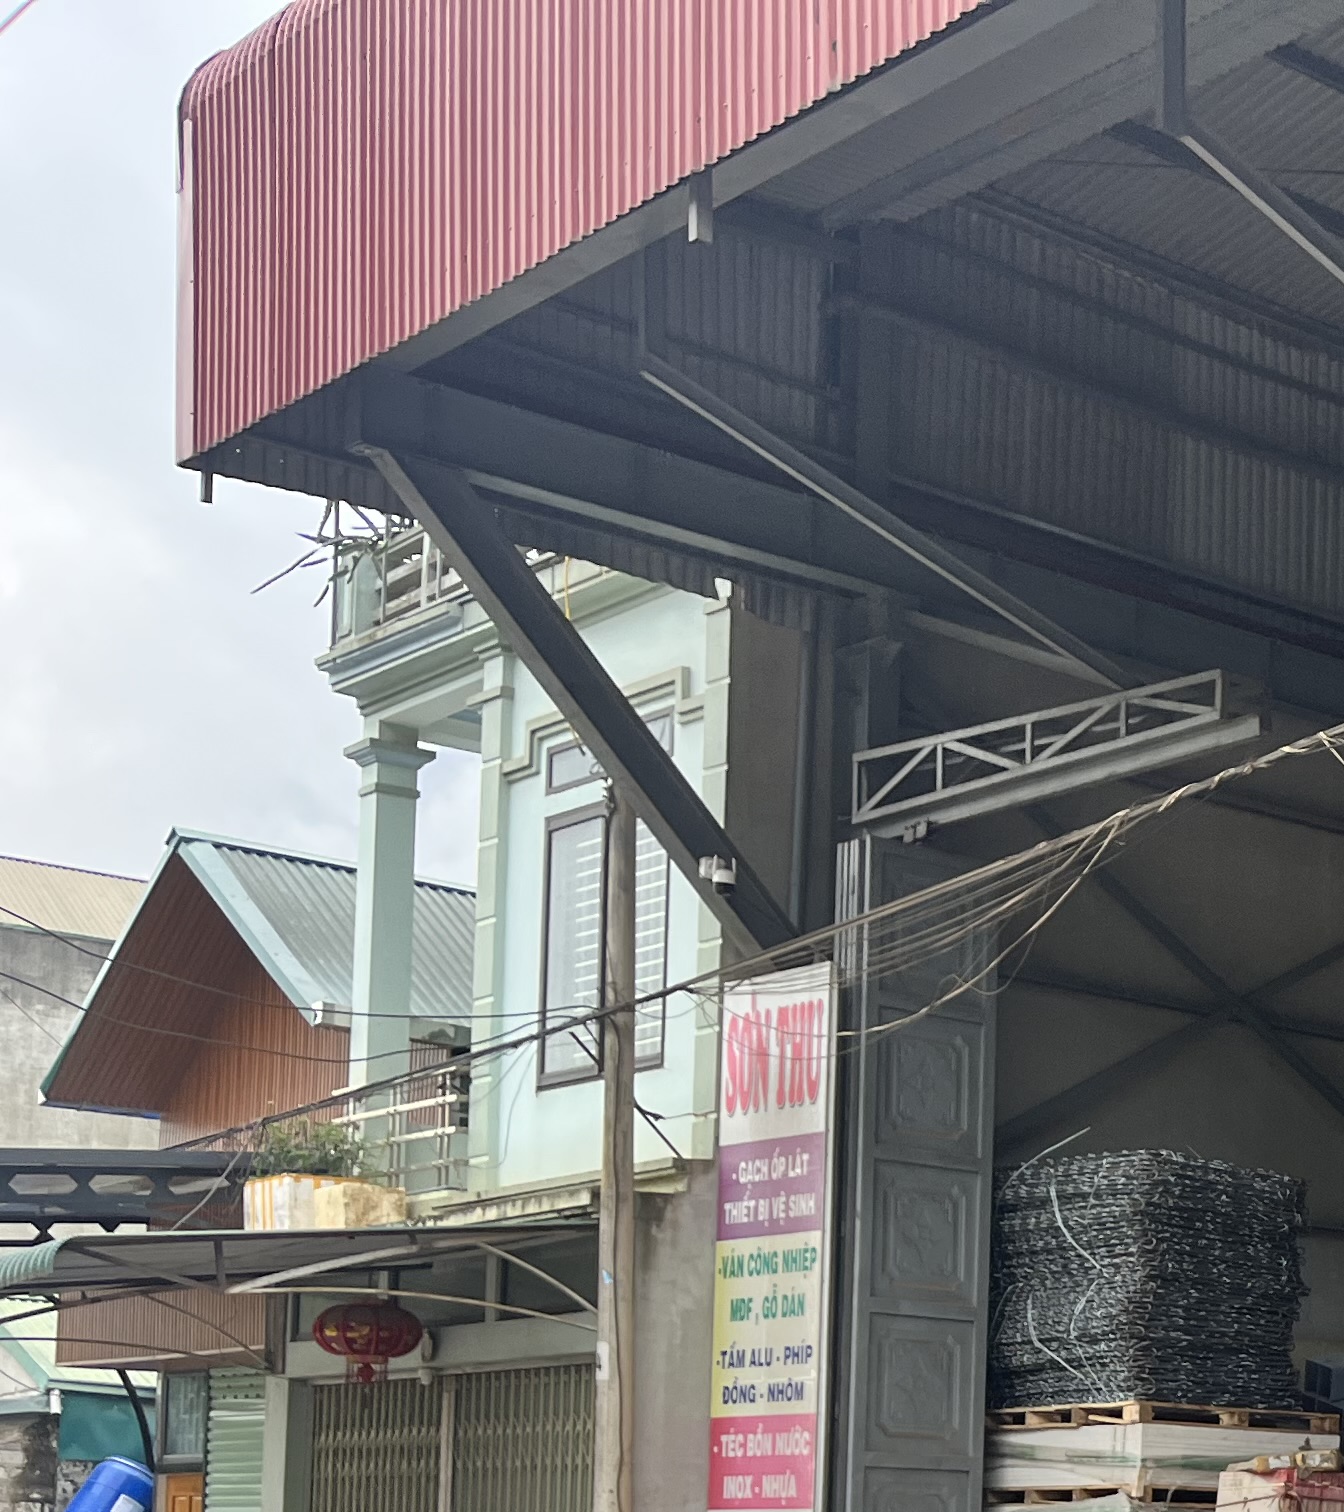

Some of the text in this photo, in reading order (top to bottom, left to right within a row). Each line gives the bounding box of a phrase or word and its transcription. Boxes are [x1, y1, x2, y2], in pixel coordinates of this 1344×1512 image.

[725, 990, 824, 1117] SƠN THU
[771, 1191, 786, 1225] VỆ
[789, 1193, 815, 1217] SINH
[747, 1246, 778, 1276] CÔNG
[782, 1242, 816, 1279] NHIỆP
[720, 1341, 745, 1369] TẤM
[749, 1348, 772, 1366] ALU
[768, 1378, 803, 1402] NHÔM
[721, 1428, 744, 1457] TÉC
[723, 1470, 797, 1505] INOX NHỰA
